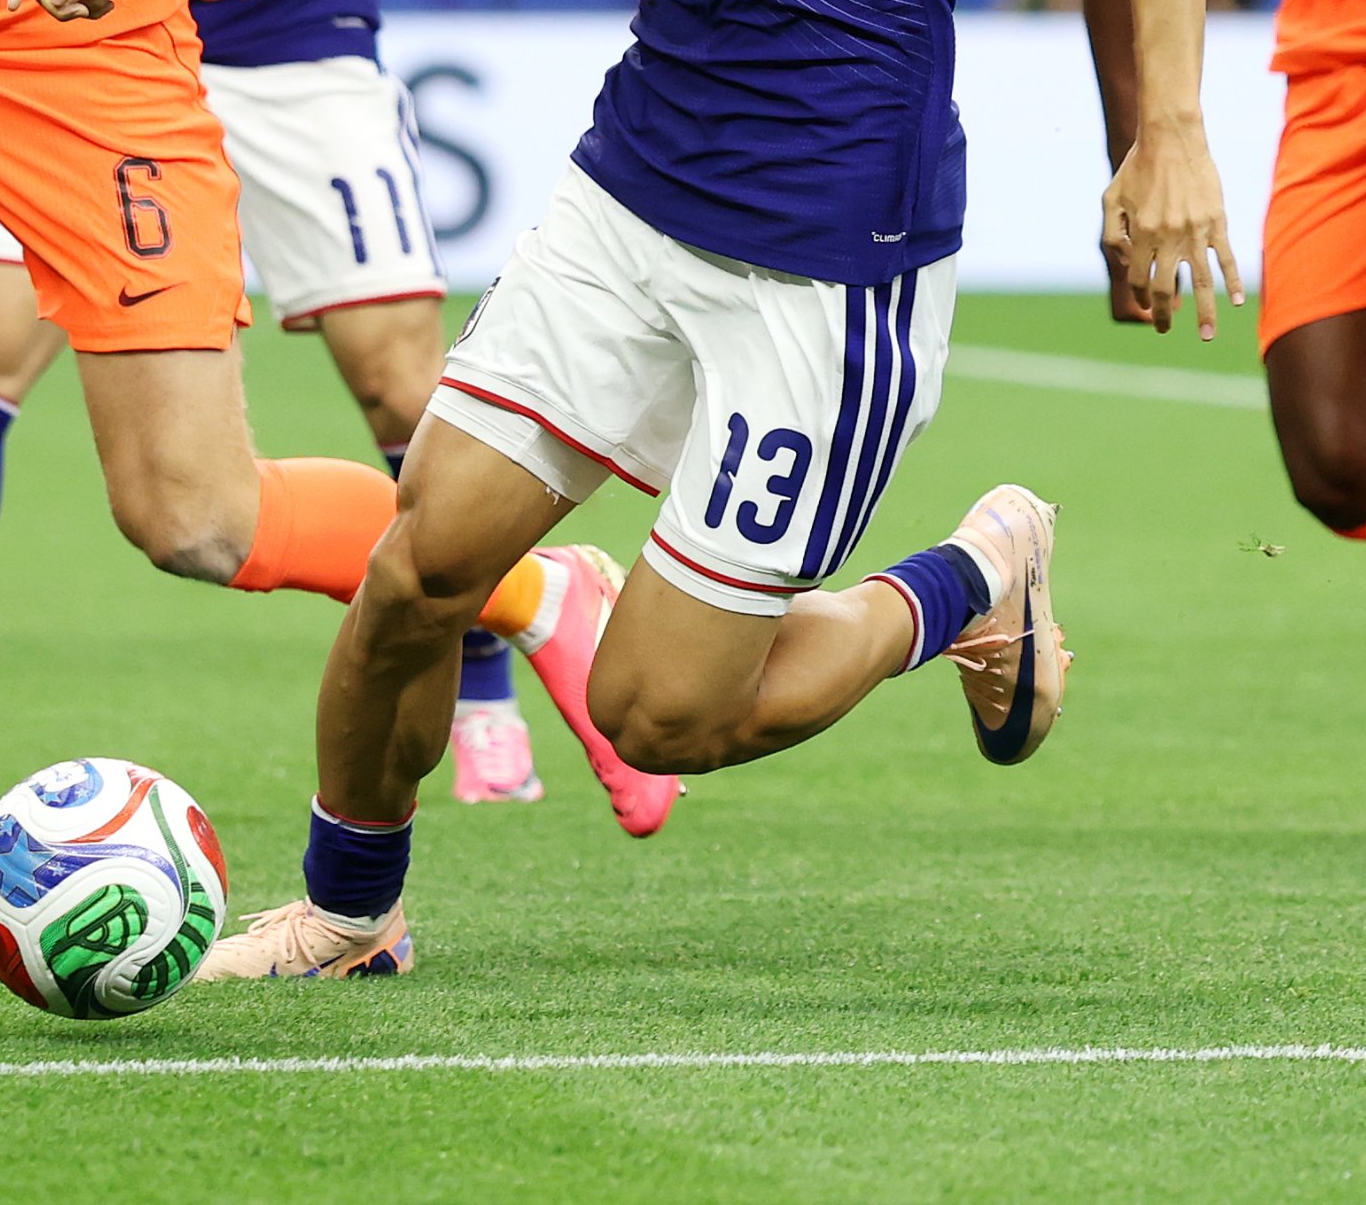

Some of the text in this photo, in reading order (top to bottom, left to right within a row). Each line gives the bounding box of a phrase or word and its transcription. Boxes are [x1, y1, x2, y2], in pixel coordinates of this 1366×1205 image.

[113, 155, 174, 261] 6
[331, 167, 411, 264] 11
[704, 411, 813, 545] 13
